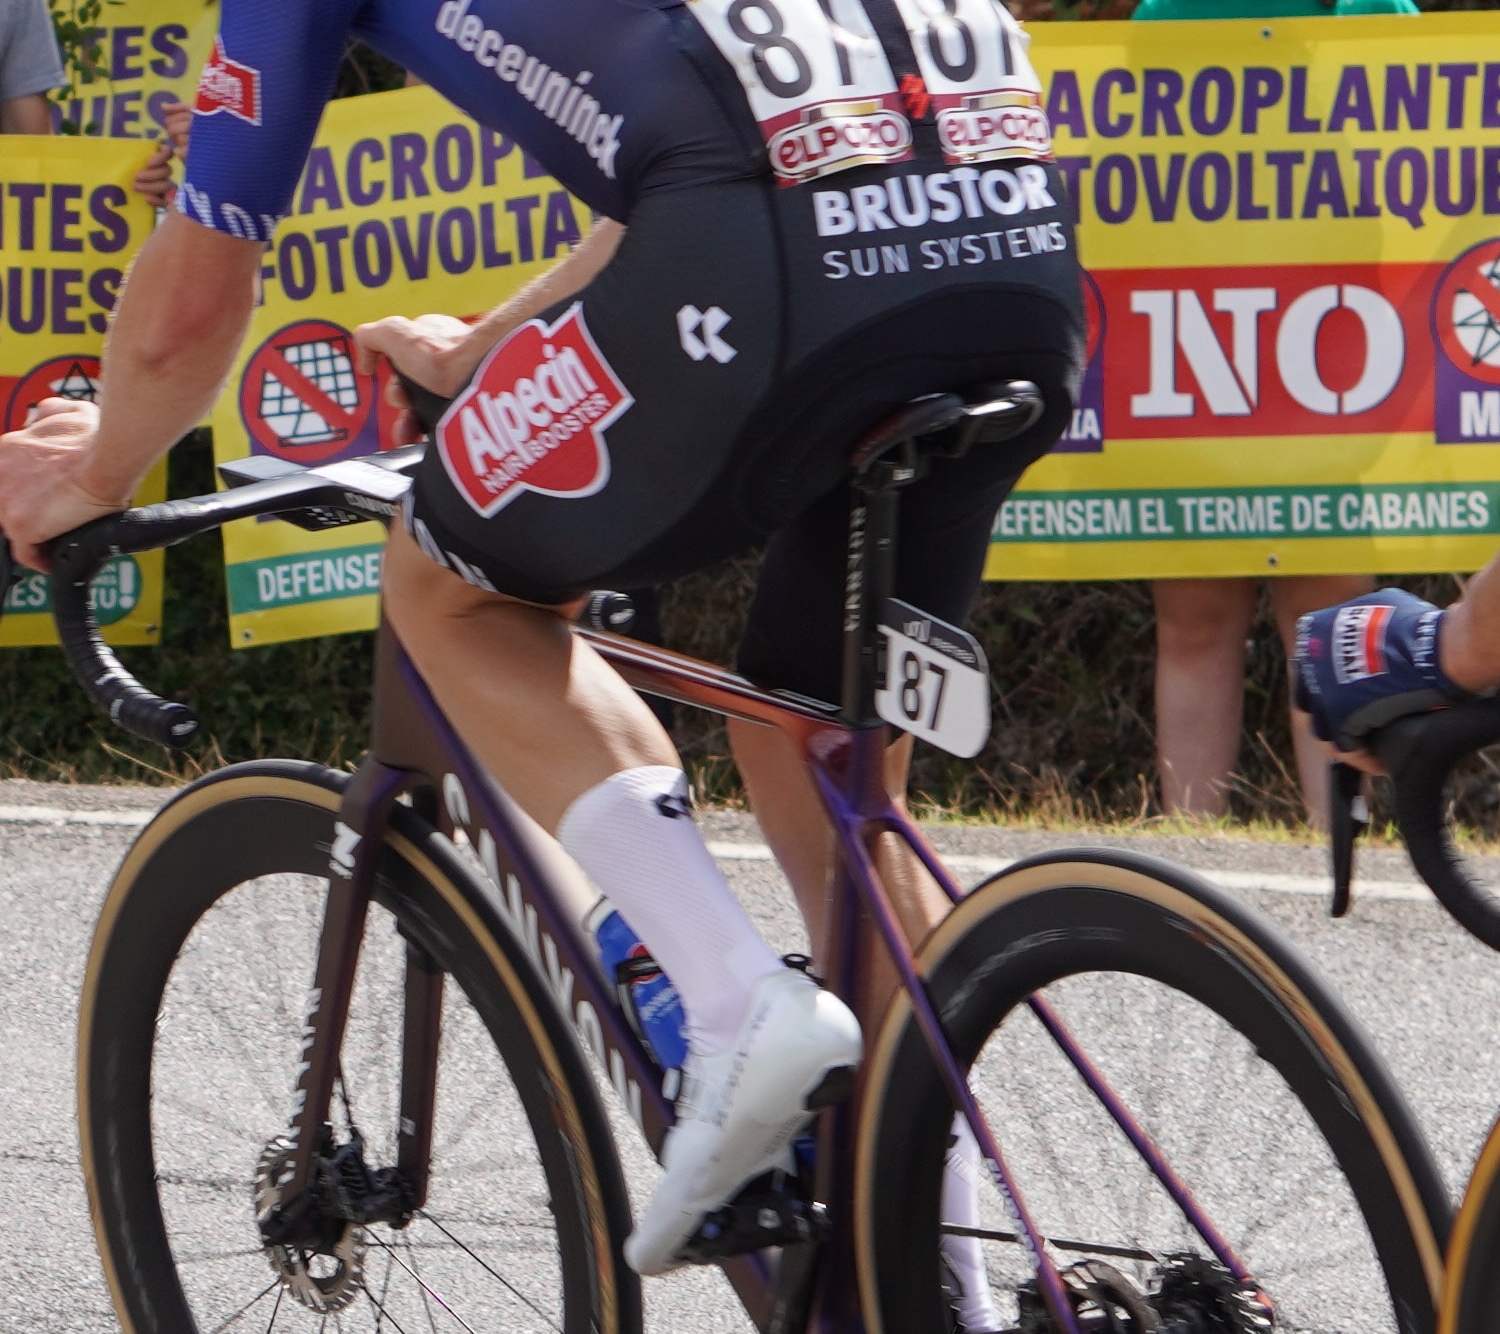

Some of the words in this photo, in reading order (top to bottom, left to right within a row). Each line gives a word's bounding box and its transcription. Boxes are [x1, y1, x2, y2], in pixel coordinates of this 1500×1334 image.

[812, 165, 1057, 237] BRUSTOR
[822, 244, 910, 280] SUN
[920, 221, 1068, 271] SYSTEMS
[1129, 284, 1407, 419] NO
[460, 343, 598, 475] Alpecin
[533, 391, 613, 464] BOOSTER
[1137, 497, 1175, 534] EL
[1177, 494, 1285, 535] TERME
[1291, 493, 1334, 531] DE
[1337, 490, 1490, 531] CABANES
[902, 650, 948, 731] 87
